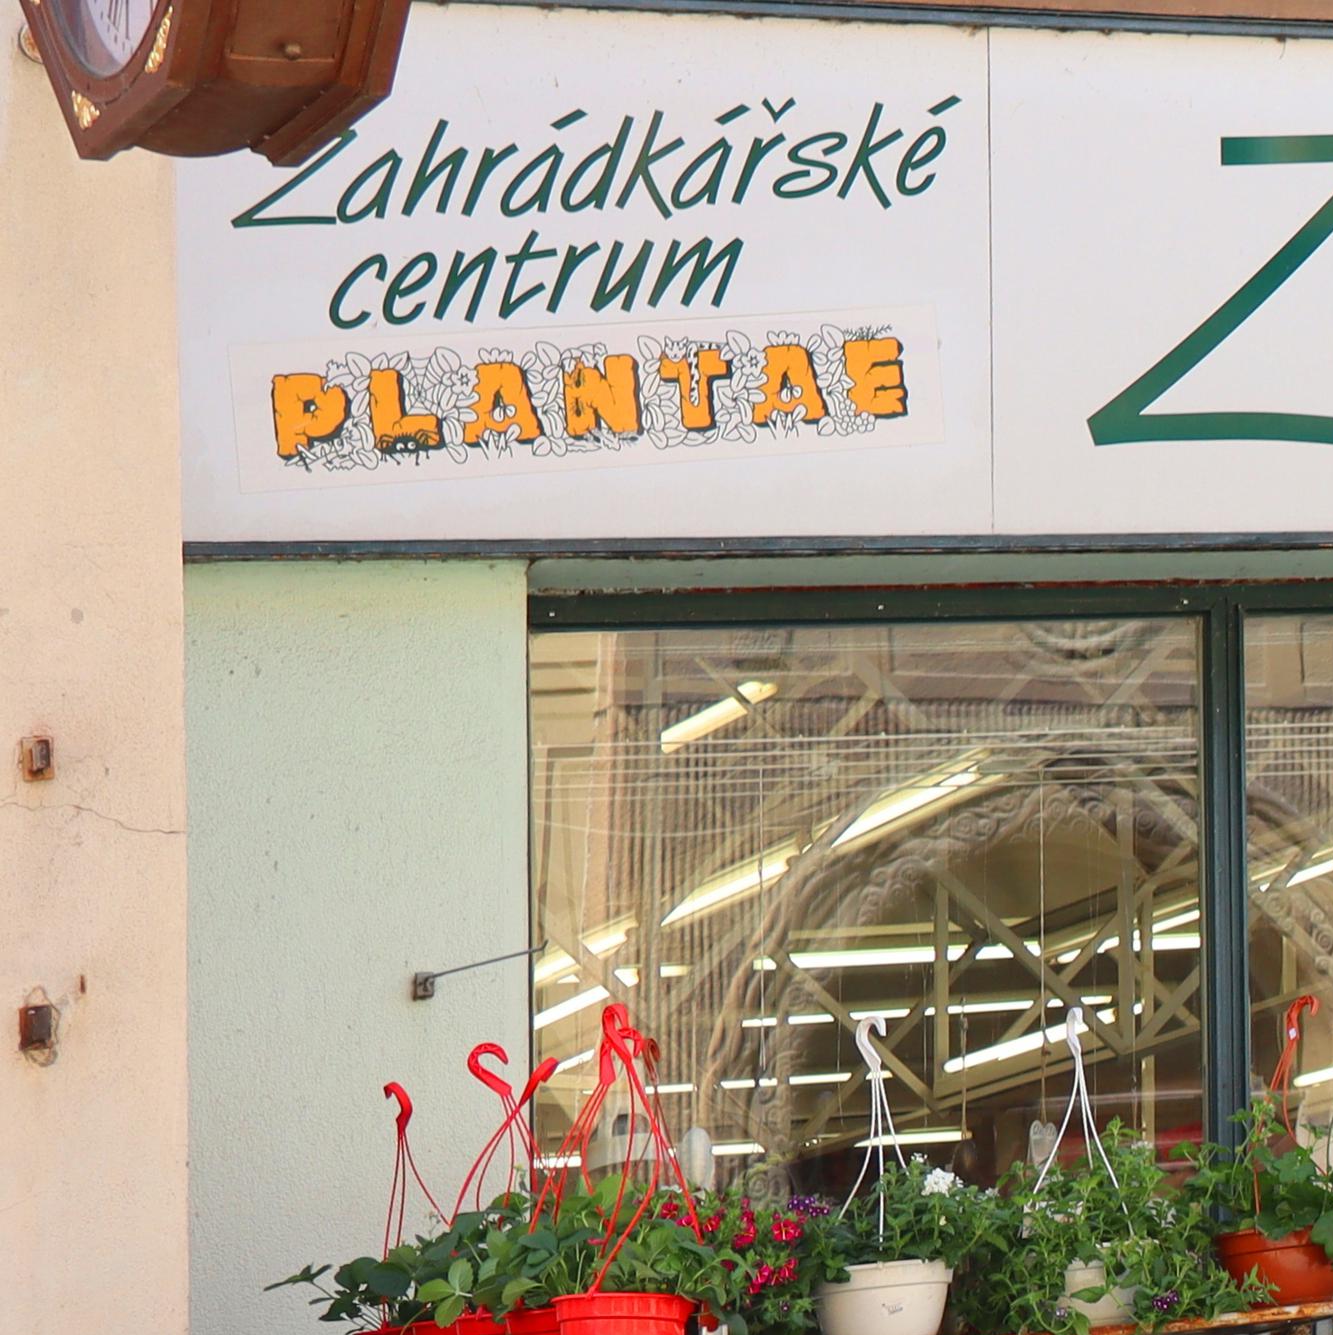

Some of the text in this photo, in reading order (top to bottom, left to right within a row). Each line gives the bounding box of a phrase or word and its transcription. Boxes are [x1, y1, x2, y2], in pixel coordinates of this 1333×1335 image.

[231, 95, 963, 228] Zahrádkářské
[328, 230, 745, 329] centrum
[271, 336, 910, 460] PLANTAE
